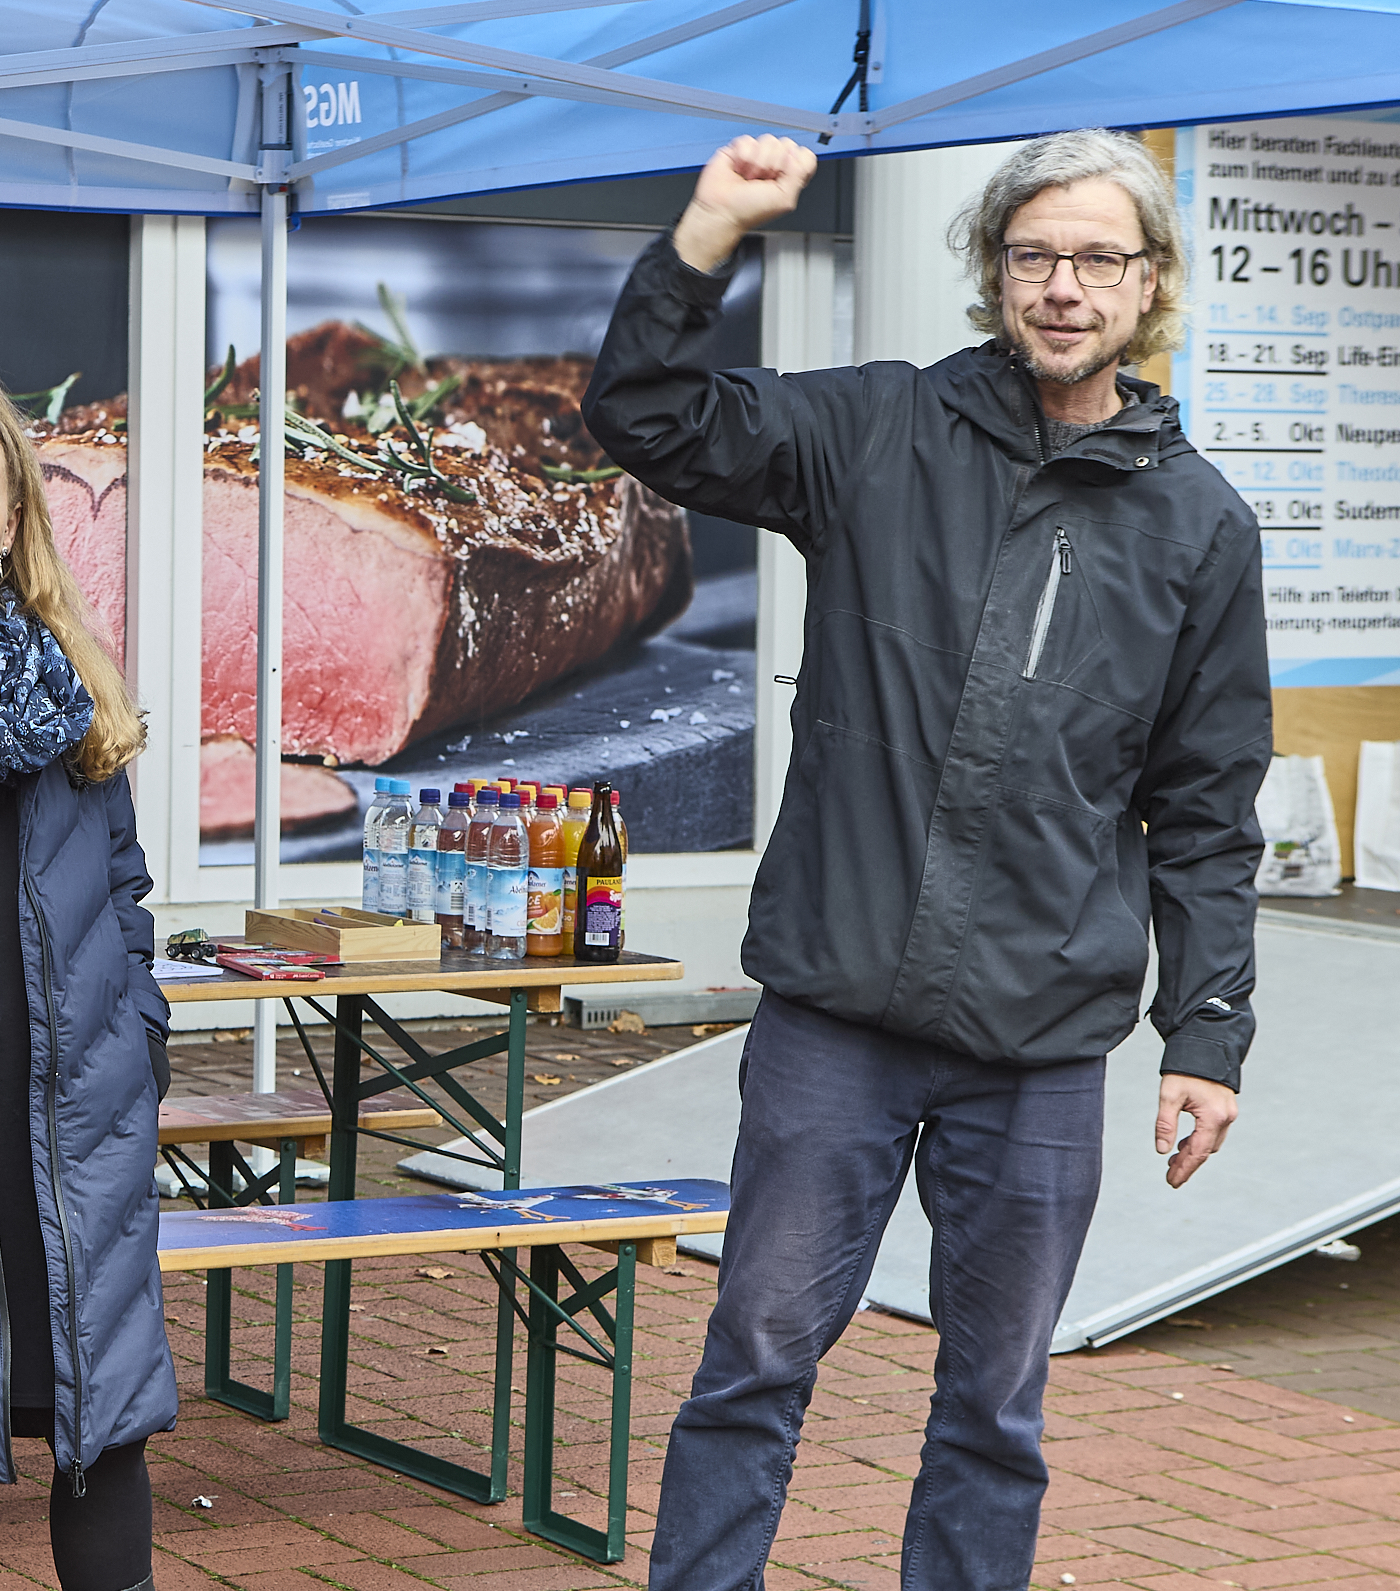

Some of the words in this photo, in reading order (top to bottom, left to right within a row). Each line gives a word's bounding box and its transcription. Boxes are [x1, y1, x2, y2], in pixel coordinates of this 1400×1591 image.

[1208, 162, 1248, 178] zum
[1252, 160, 1322, 182] Internet
[1327, 166, 1363, 185] und
[1208, 196, 1364, 236] Mittwoch
[1211, 245, 1250, 282] 12
[1290, 248, 1330, 286] 16
[1343, 249, 1400, 288] Uh
[1291, 344, 1329, 370] Sep
[1289, 422, 1324, 442] Okt
[1287, 500, 1322, 520] Okt
